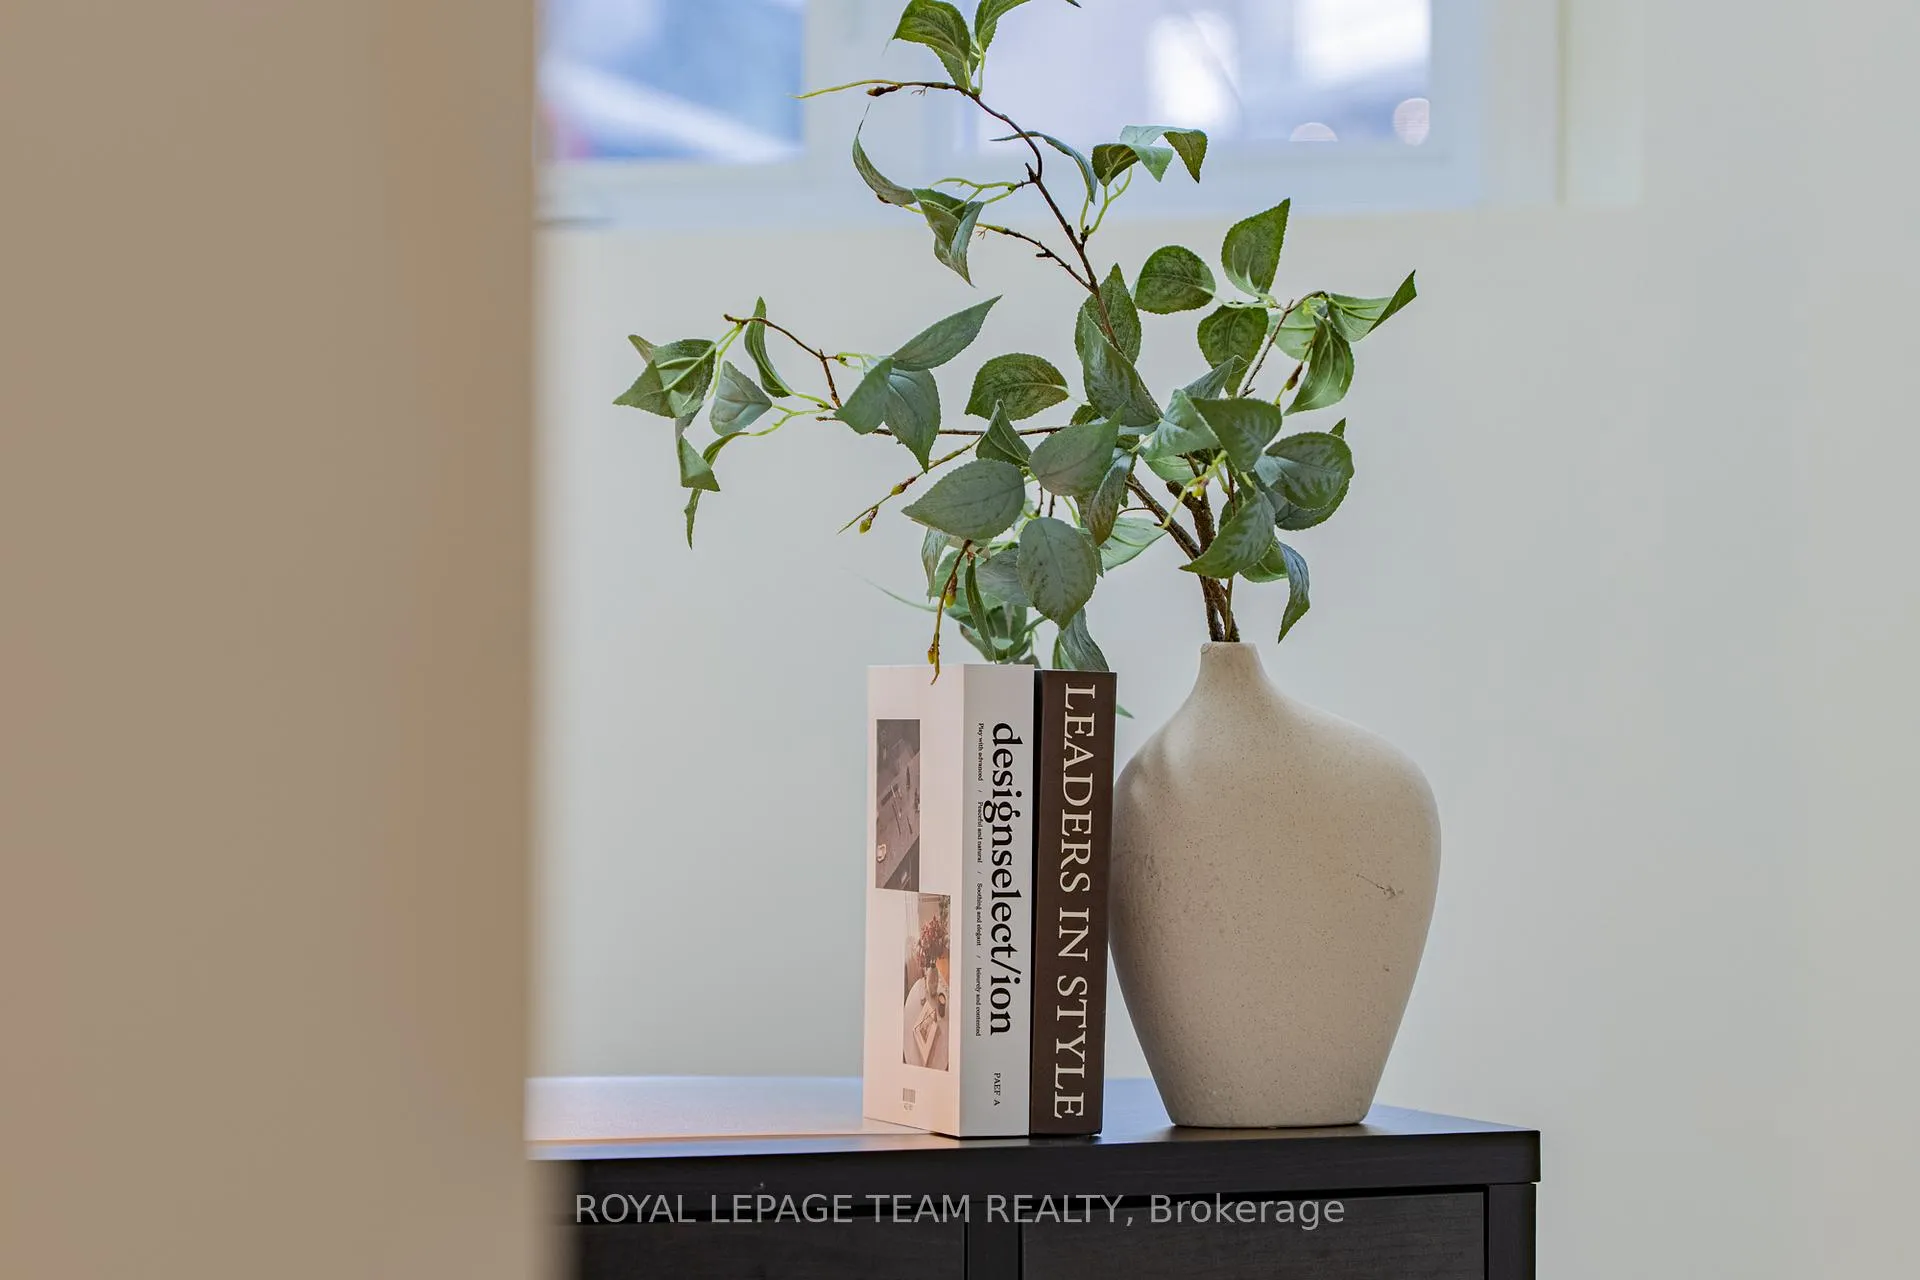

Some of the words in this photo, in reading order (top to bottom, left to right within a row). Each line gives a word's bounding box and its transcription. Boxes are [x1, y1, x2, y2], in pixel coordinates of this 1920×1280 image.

[1059, 683, 1096, 893] LEADERS
[983, 722, 1024, 1035] designselect/ion
[1057, 907, 1090, 962] IN
[993, 1072, 1001, 1096] PAEF
[1054, 975, 1088, 1119] STYLE
[993, 1099, 1001, 1107] A
